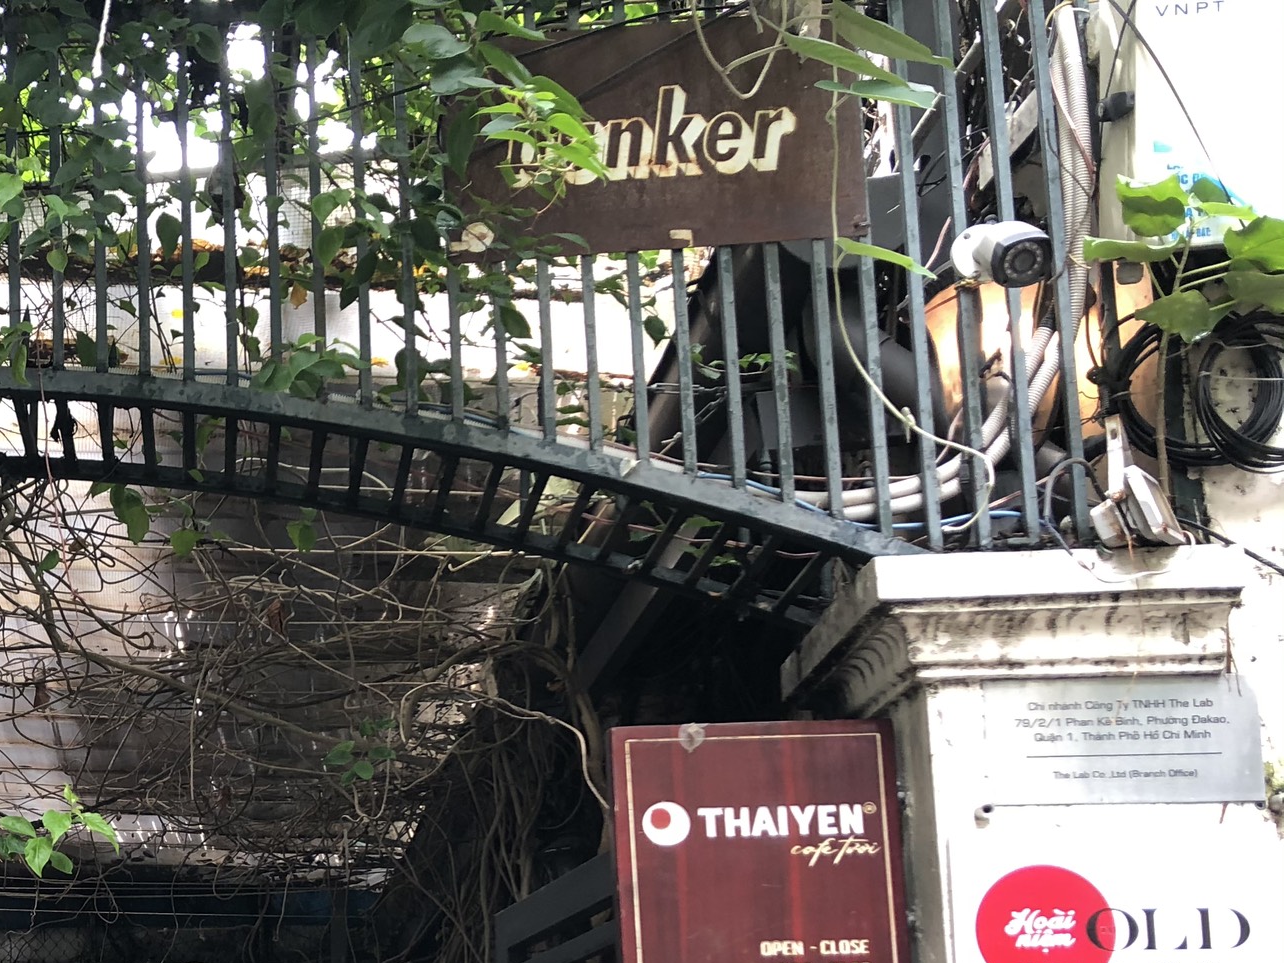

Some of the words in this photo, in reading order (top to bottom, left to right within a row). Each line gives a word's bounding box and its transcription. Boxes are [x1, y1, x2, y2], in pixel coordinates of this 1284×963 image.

[1155, 0, 1224, 17] VNPT
[506, 83, 797, 187] nker
[1133, 699, 1165, 709] TNHH
[1169, 698, 1189, 708] The
[1194, 698, 1213, 708] Lab
[1015, 718, 1061, 729] 79/2/1
[1066, 717, 1094, 727] Phan
[1184, 729, 1212, 739] Minh
[1053, 771, 1070, 779] The
[1073, 771, 1090, 779] Lab
[698, 804, 865, 837] THAIYEN
[1086, 908, 1251, 951] OLD
[760, 940, 804, 956] OPEN
[820, 939, 869, 955] CLOSE
